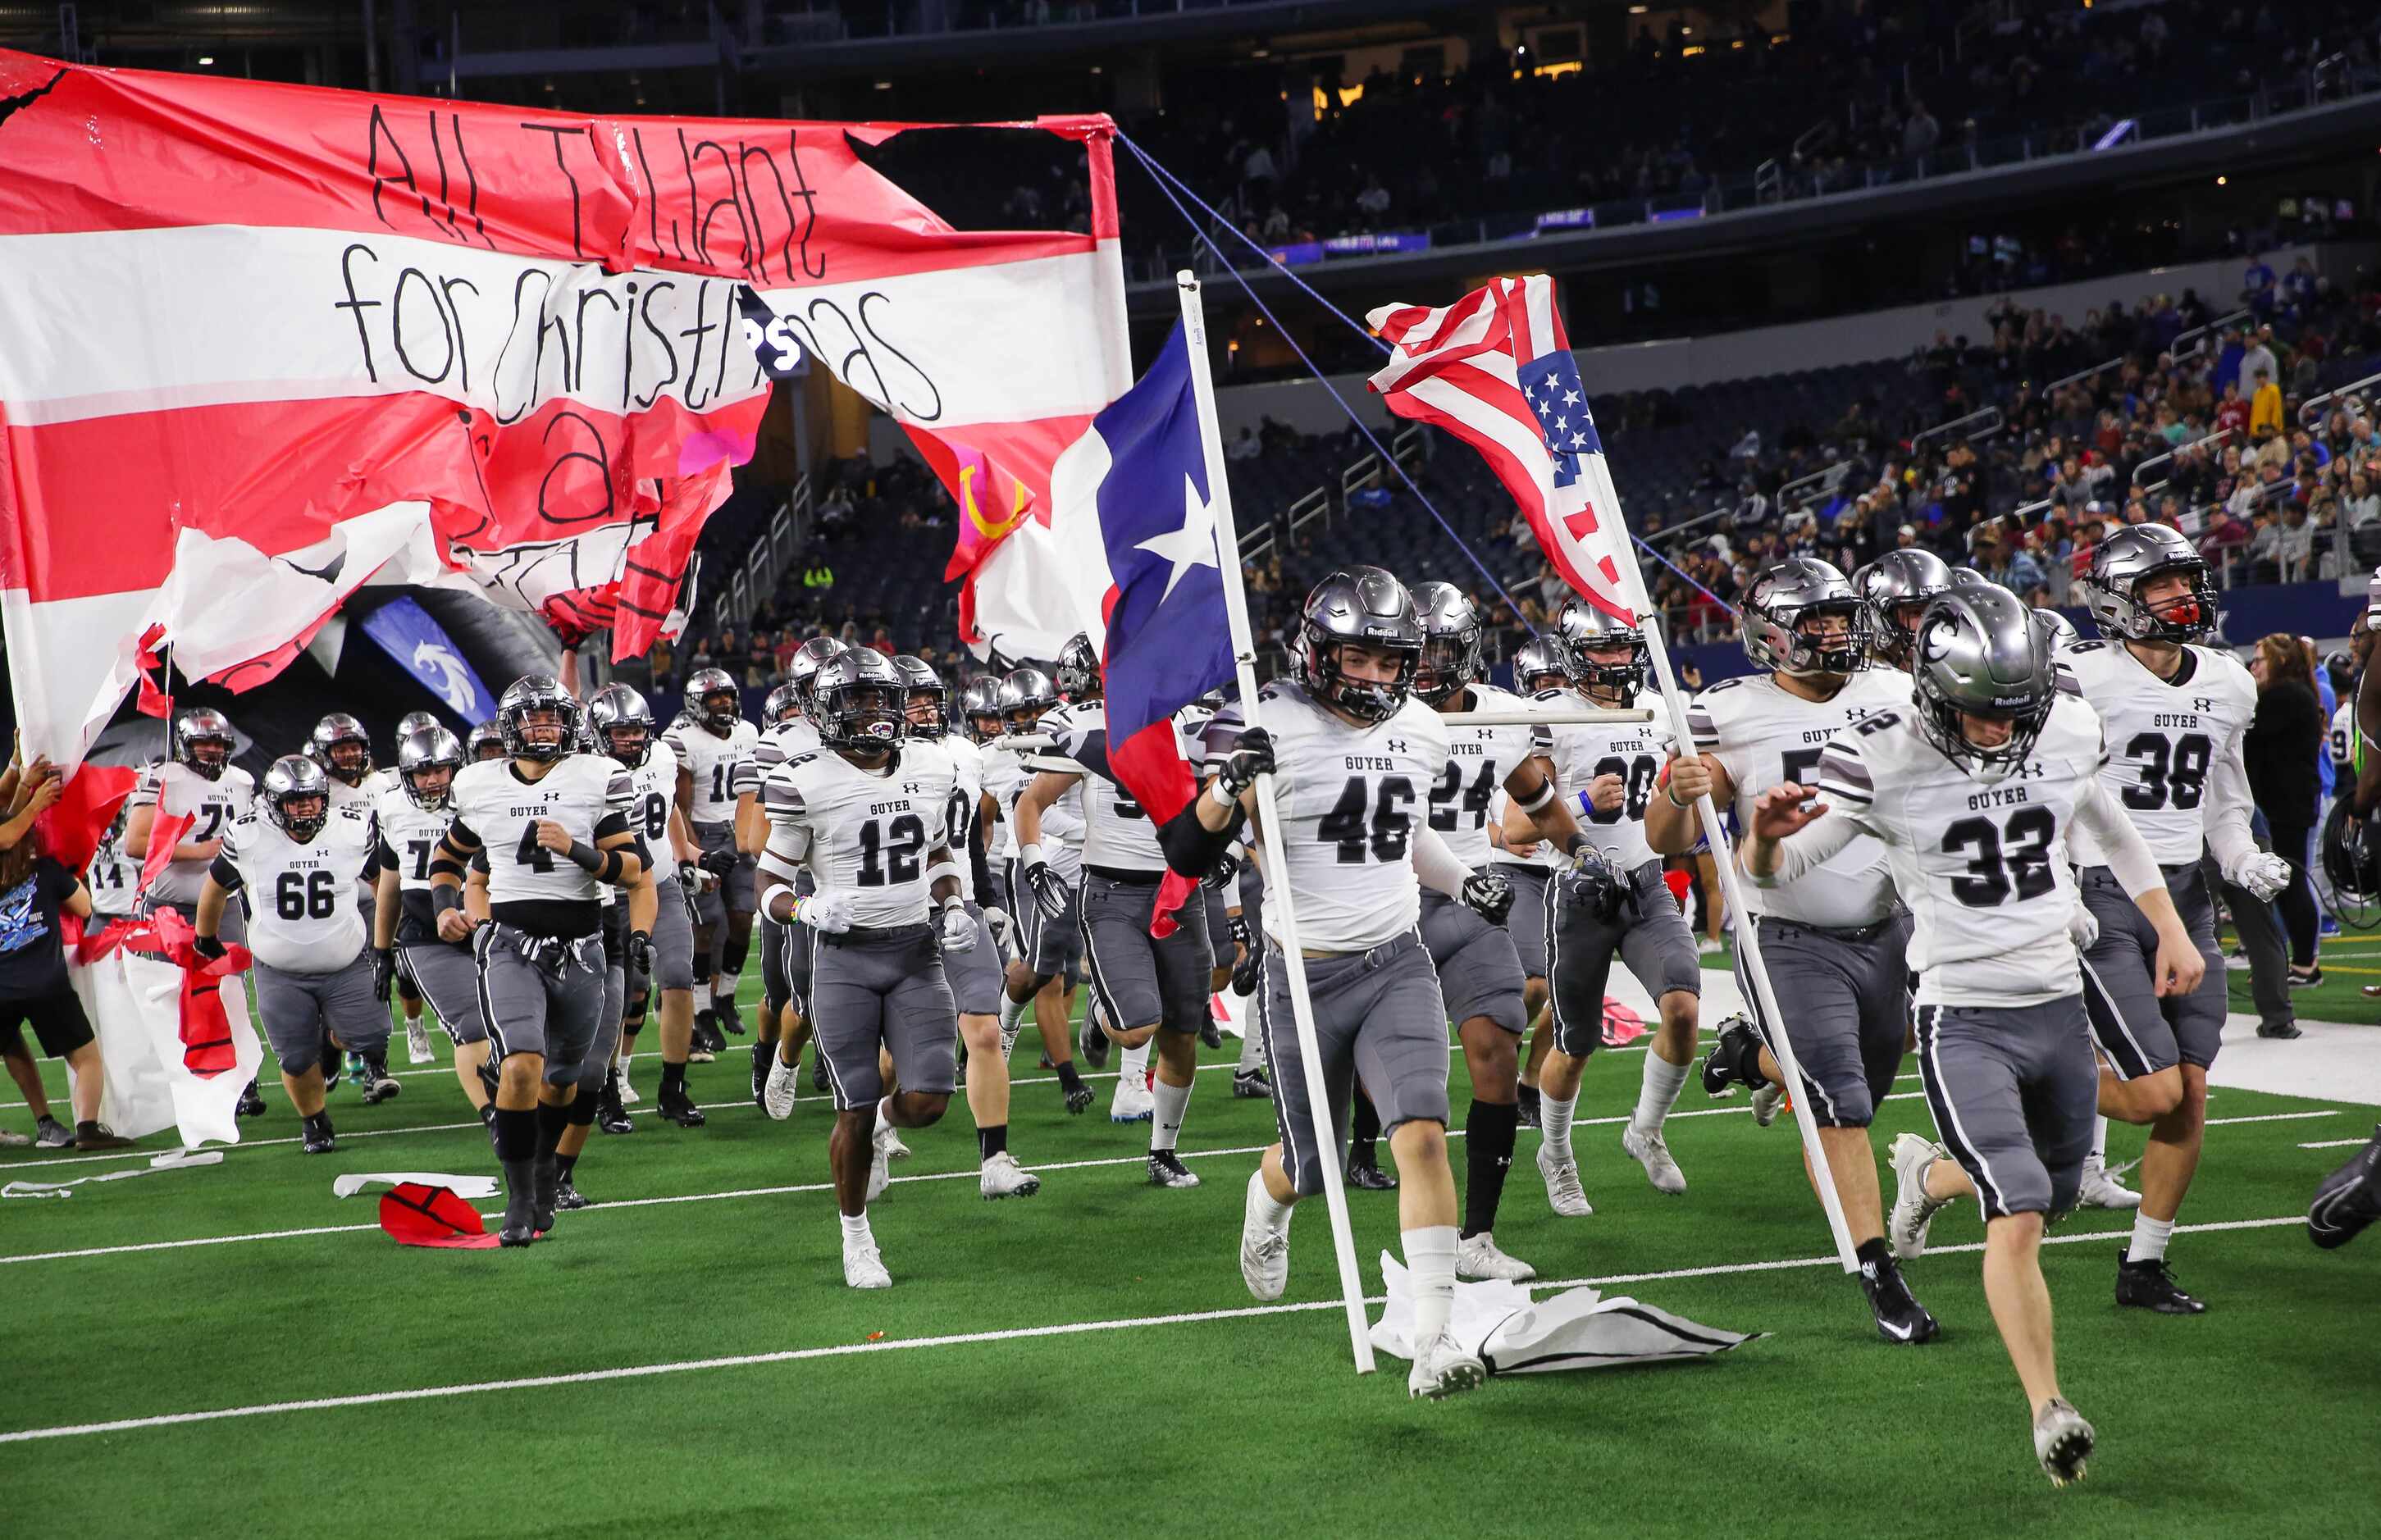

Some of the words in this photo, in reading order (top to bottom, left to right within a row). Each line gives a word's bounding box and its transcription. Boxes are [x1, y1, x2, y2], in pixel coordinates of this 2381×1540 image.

[368, 104, 497, 249] All
[631, 127, 826, 285] Want
[334, 244, 480, 393] for
[539, 412, 614, 524] a
[1367, 626, 1398, 637] Riddell
[1994, 695, 2031, 707] Riddell
[2154, 713, 2198, 729] GUYER
[1344, 756, 1394, 771] GUYER
[1610, 740, 1644, 753] GUYER
[2120, 731, 2213, 810] 38
[510, 805, 549, 818] GUYER
[870, 799, 911, 816] GUYER
[1317, 774, 1416, 863] 46
[1427, 759, 1496, 832] 24
[1968, 786, 2029, 811] GUYER
[516, 819, 556, 874] 4
[856, 813, 926, 887] 12
[1941, 804, 2056, 908] 32
[94, 863, 125, 889] 14
[276, 870, 335, 921] 66
